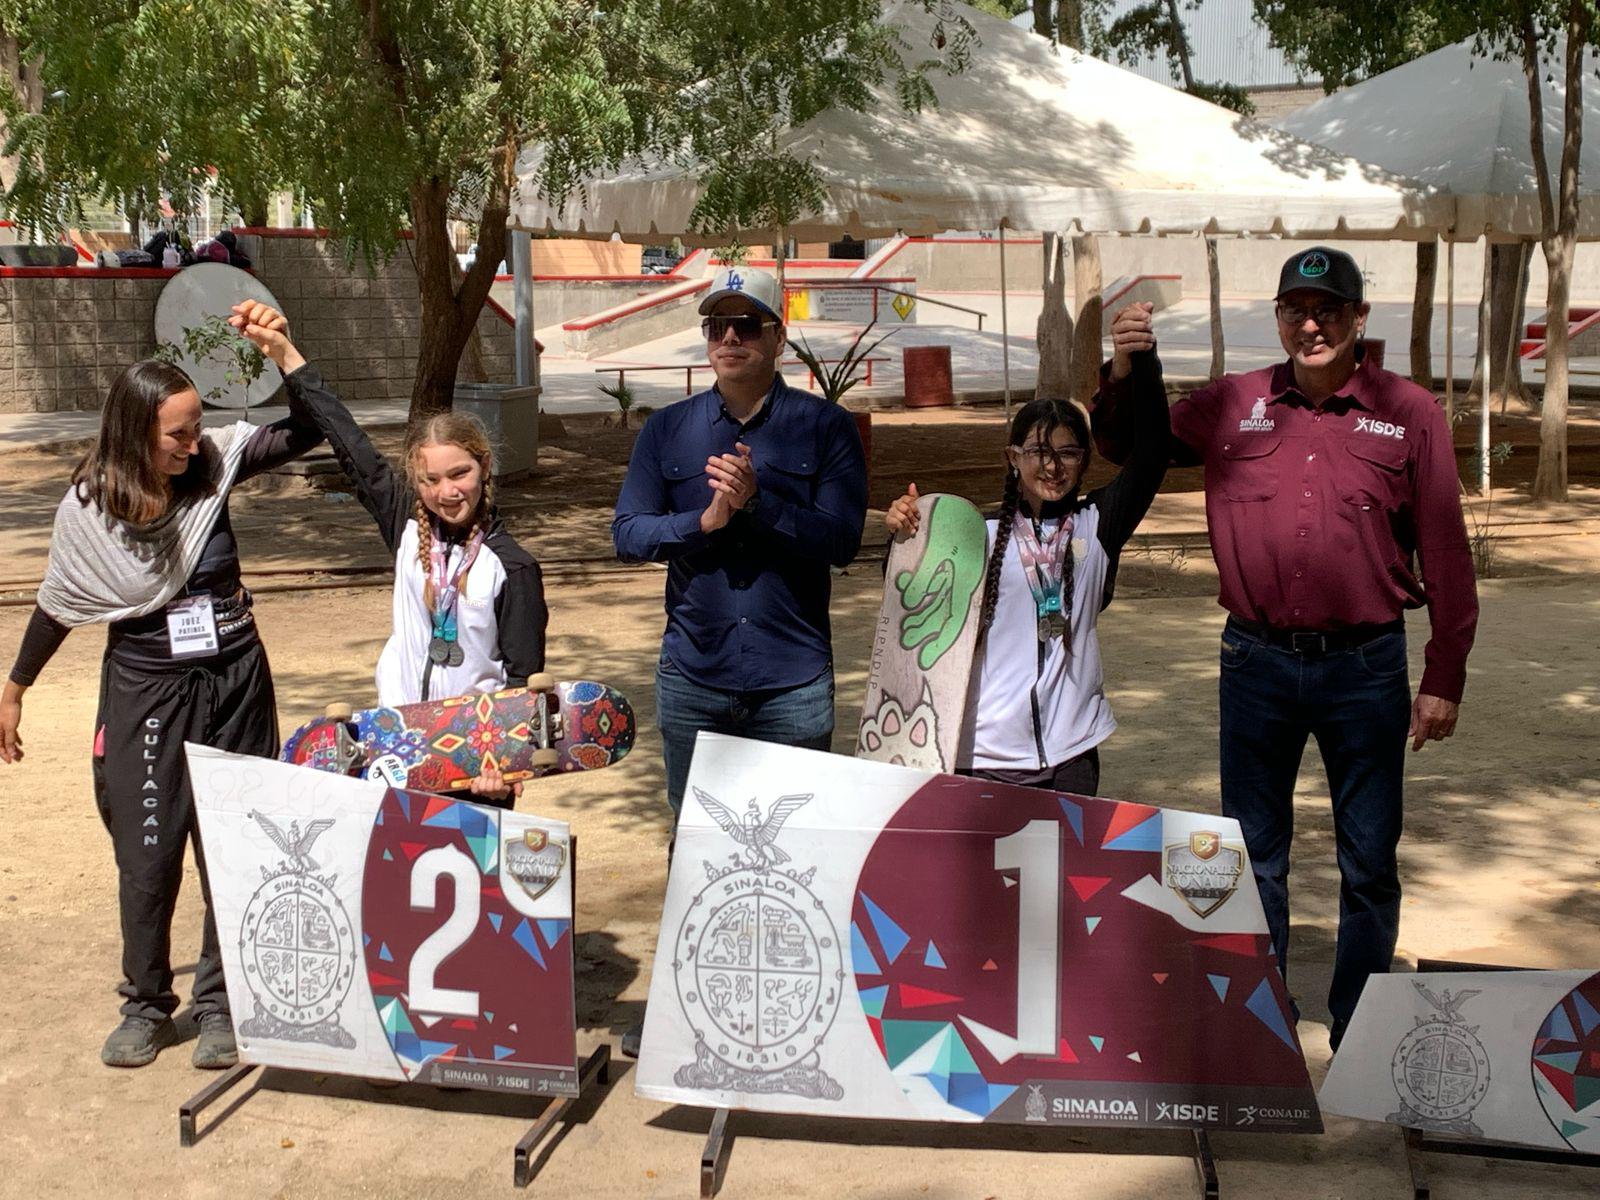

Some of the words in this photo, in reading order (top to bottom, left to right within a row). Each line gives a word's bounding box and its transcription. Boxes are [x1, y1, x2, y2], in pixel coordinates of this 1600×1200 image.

[726, 269, 745, 291] LA
[1239, 419, 1275, 428] SINALOA
[1370, 419, 1406, 439] ISDE
[181, 616, 201, 626] JUEZ
[869, 616, 889, 690] RIPNDIP
[384, 758, 407, 783] ARGO
[142, 718, 160, 846] CULIACÁN
[1167, 863, 1242, 876] NACIONALES
[274, 878, 325, 898] SINALOA
[723, 878, 796, 899] SINALOA
[1167, 874, 1239, 890] CONADE
[408, 842, 481, 1017] 2
[994, 819, 1059, 1055] 1
[1425, 1027, 1467, 1039] SINALOA
[444, 1069, 489, 1083] SINALOA
[505, 1078, 530, 1089] ISDE
[1052, 1097, 1139, 1115] SINALOA
[1173, 1103, 1220, 1122] ISDE
[1259, 1107, 1311, 1120] CONADE
